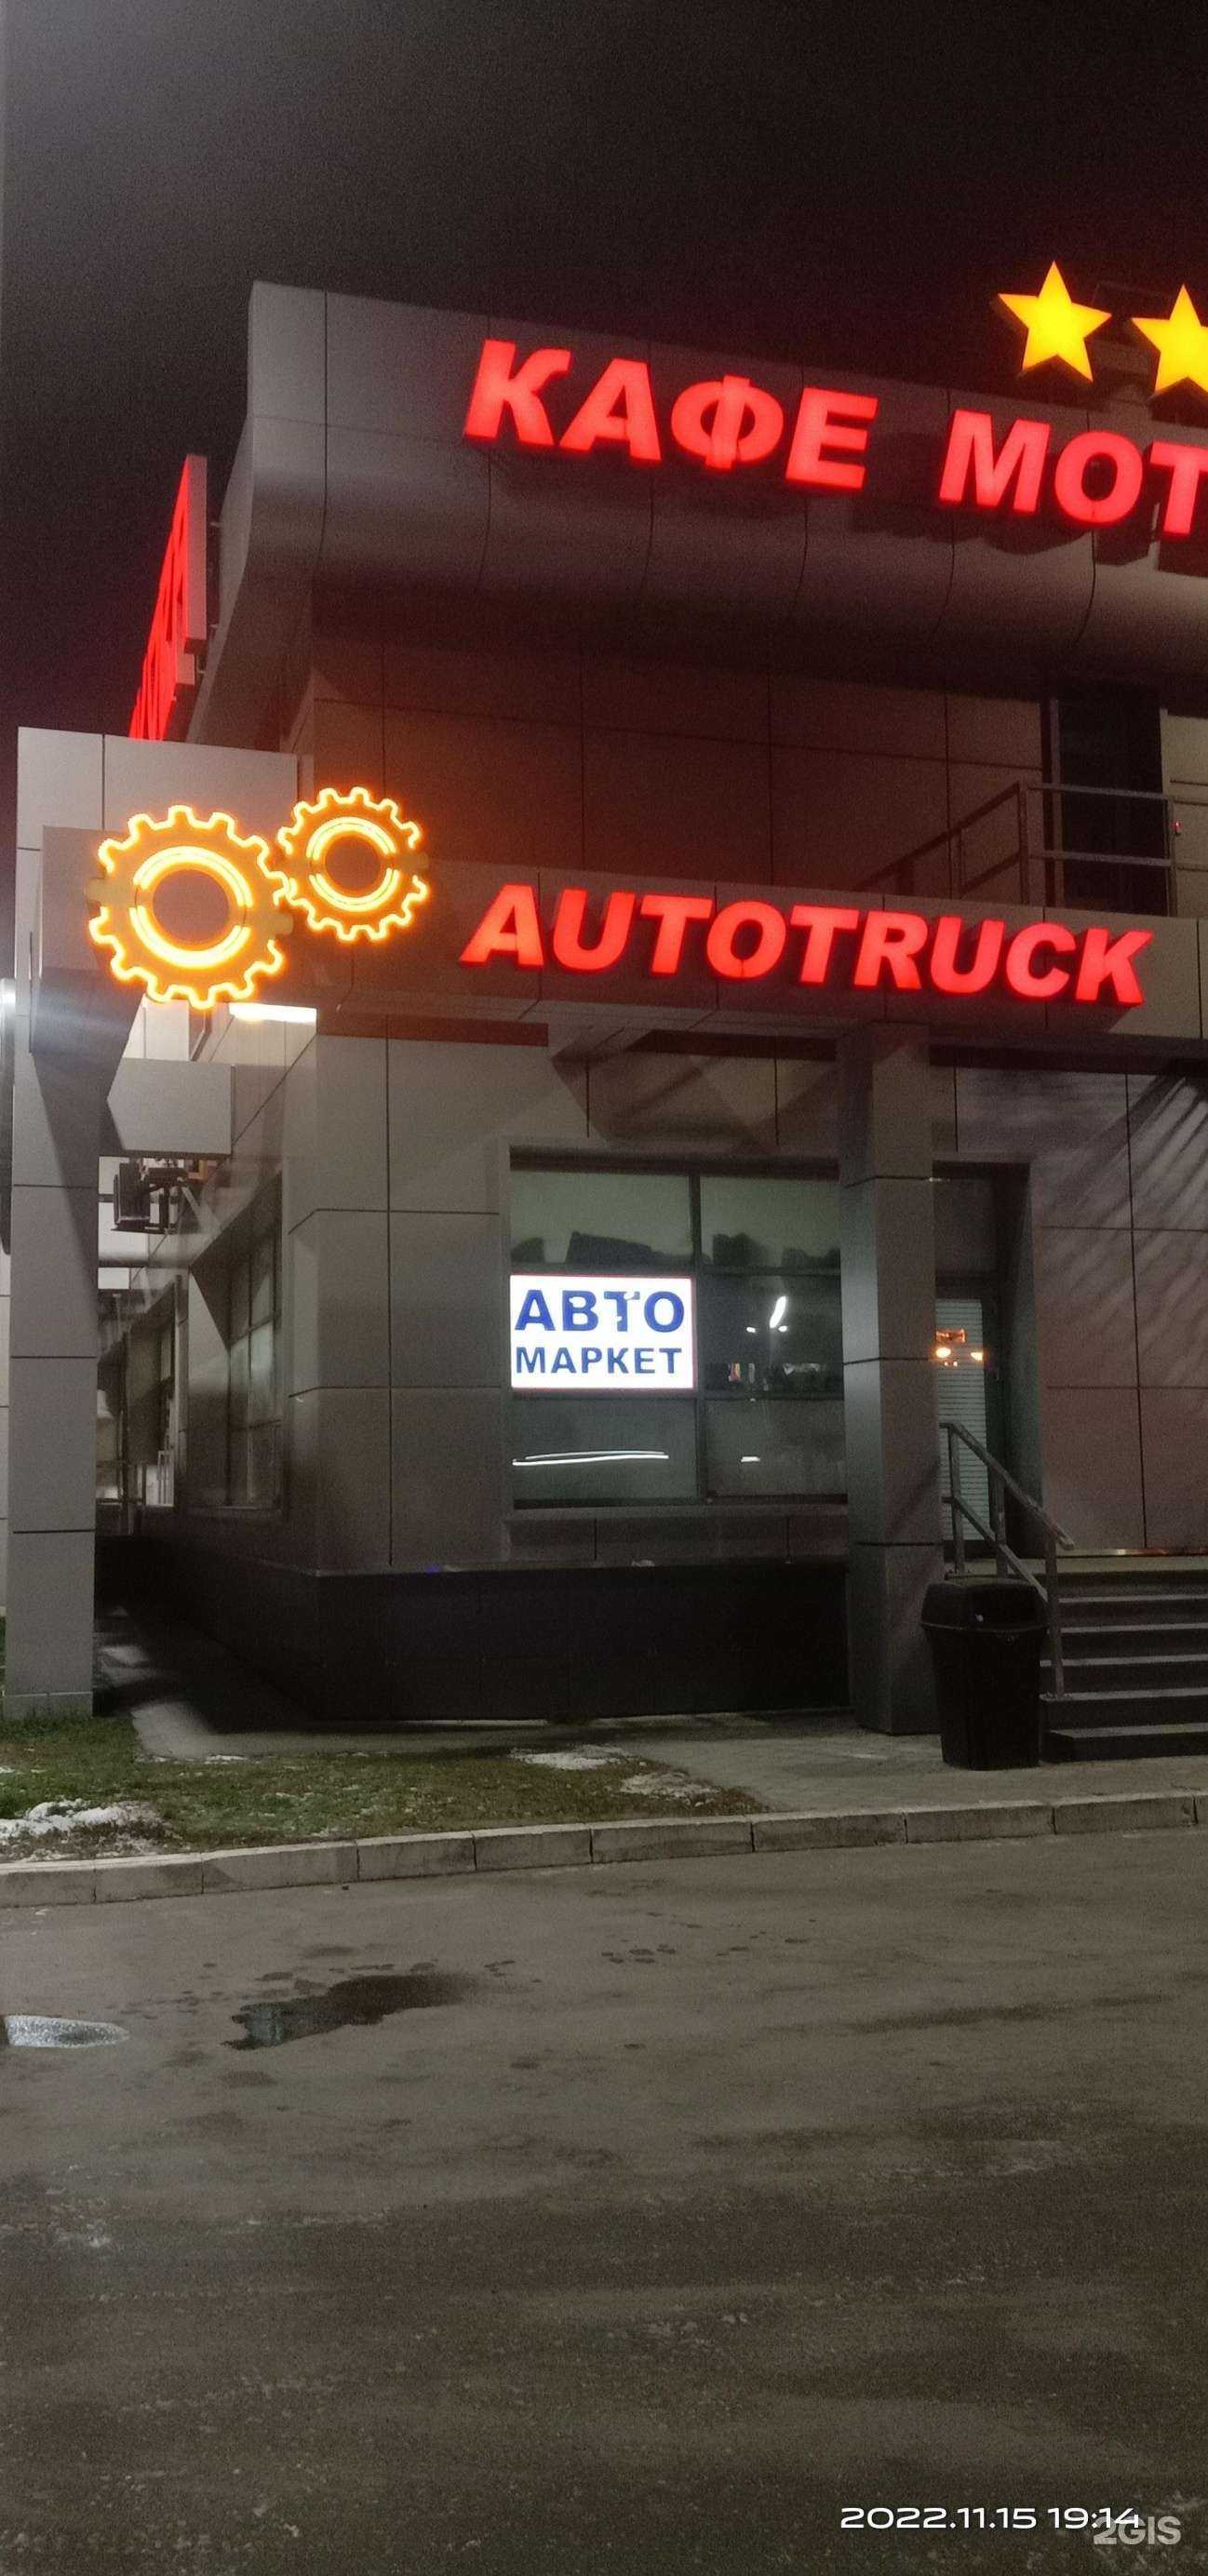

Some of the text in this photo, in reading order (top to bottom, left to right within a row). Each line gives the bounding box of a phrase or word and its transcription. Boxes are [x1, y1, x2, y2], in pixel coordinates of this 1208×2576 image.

[464, 339, 878, 490] КАФЕ
[459, 884, 1153, 1005] AUTOTRUCK
[515, 1289, 685, 1333] АВТО
[516, 1347, 682, 1375] МАРКЕТ
